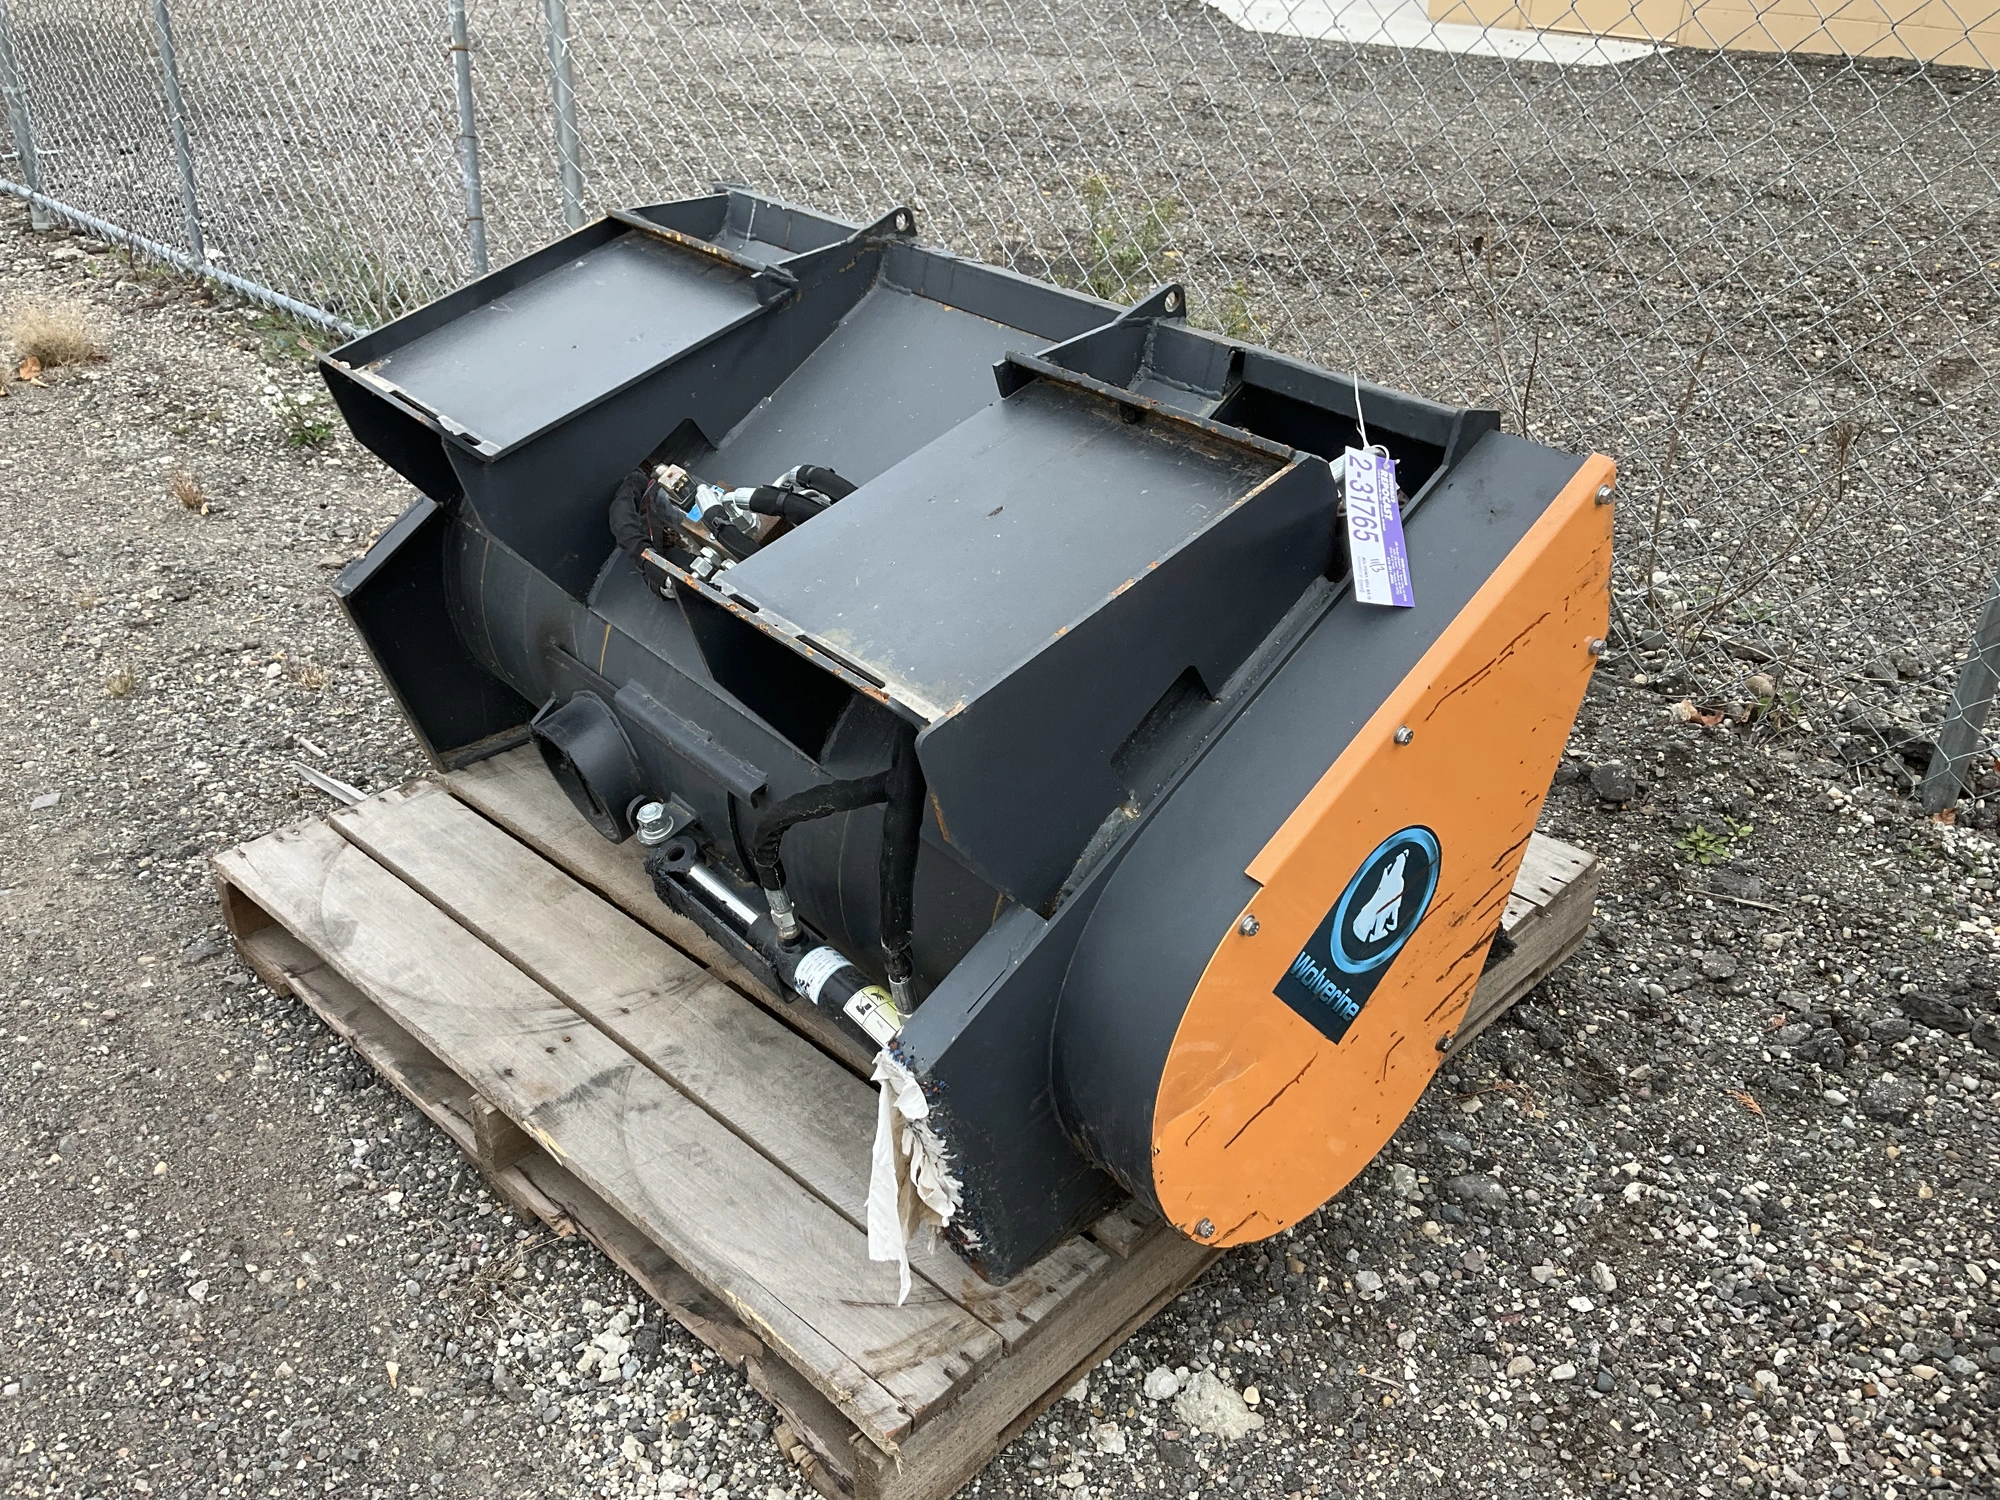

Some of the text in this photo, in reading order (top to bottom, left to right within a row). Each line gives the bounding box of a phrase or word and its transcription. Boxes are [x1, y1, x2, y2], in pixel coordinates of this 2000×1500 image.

[1349, 454, 1379, 543] 2-31765
[1380, 469, 1393, 521] REPOCAST
[1290, 951, 1359, 1021] Wolverine
